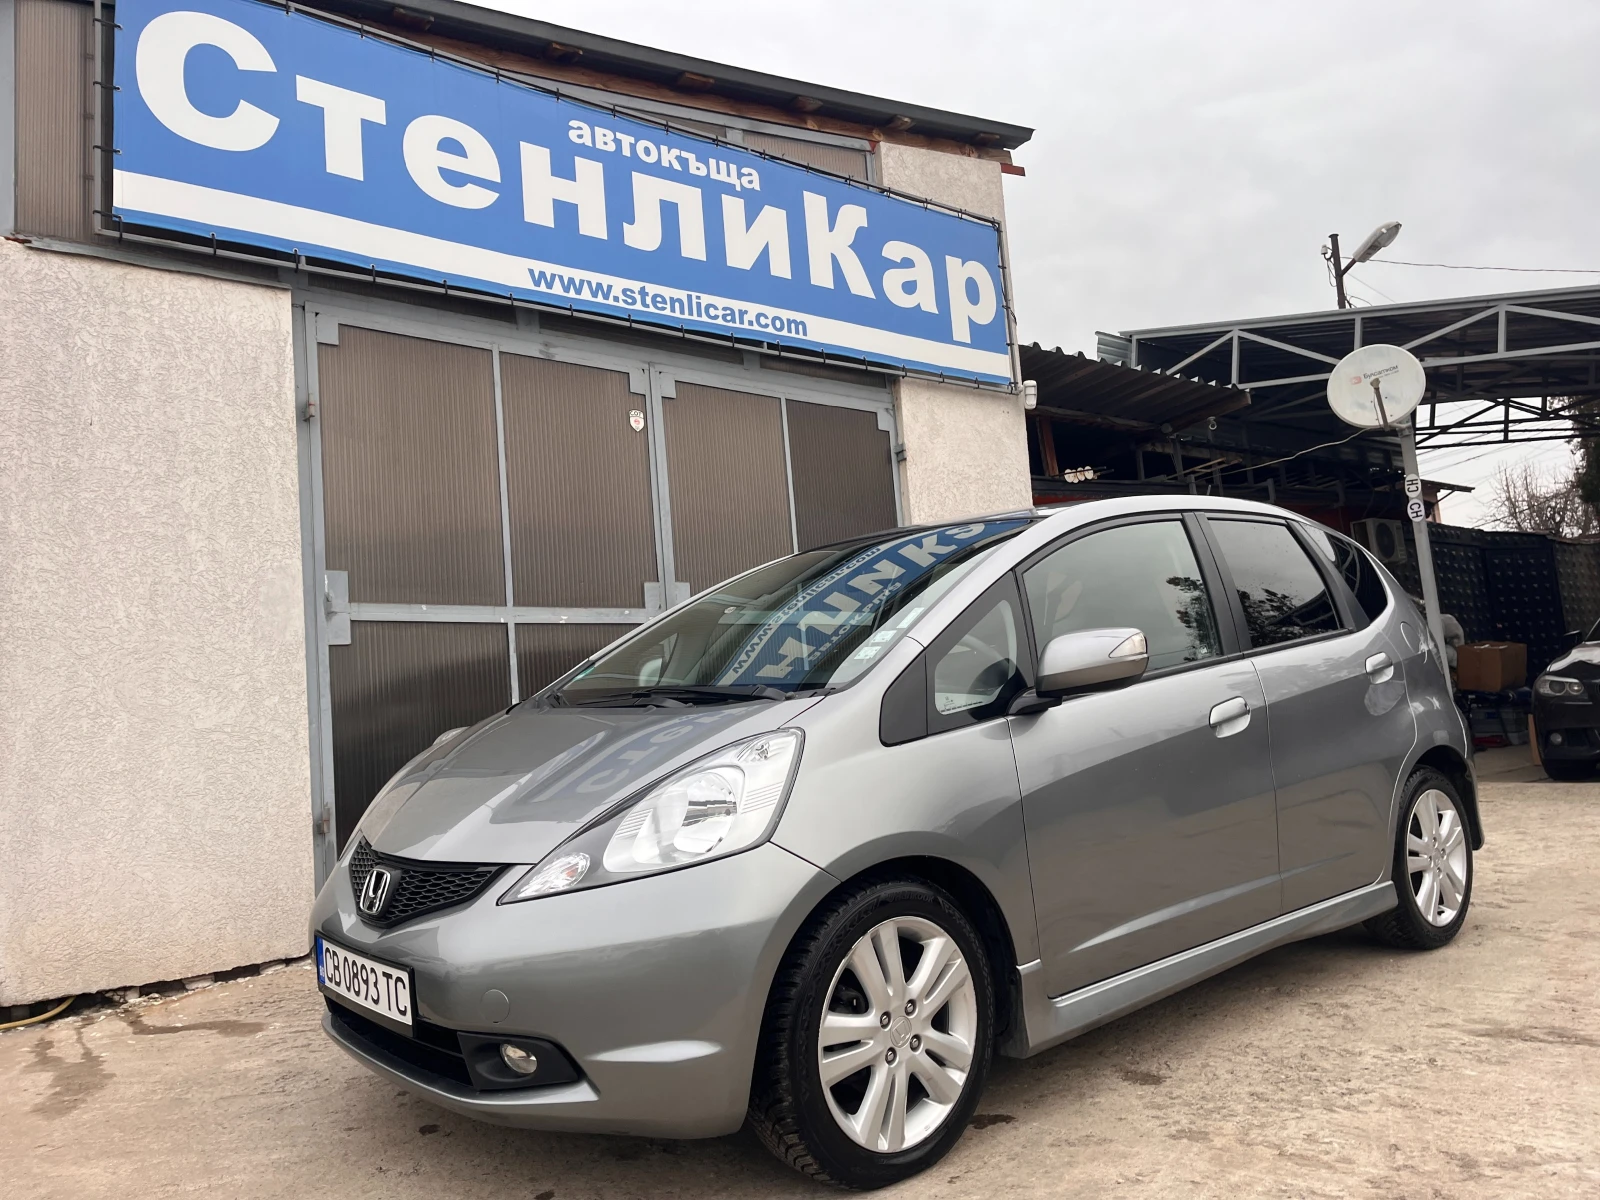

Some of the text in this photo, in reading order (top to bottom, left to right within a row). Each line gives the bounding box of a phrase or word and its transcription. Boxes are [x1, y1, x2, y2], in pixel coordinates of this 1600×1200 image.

[135, 10, 997, 344] СтенлиКар
[567, 119, 761, 192] автокъща
[527, 267, 808, 338] www.stenlicar.com
[1410, 502, 1423, 519] CH
